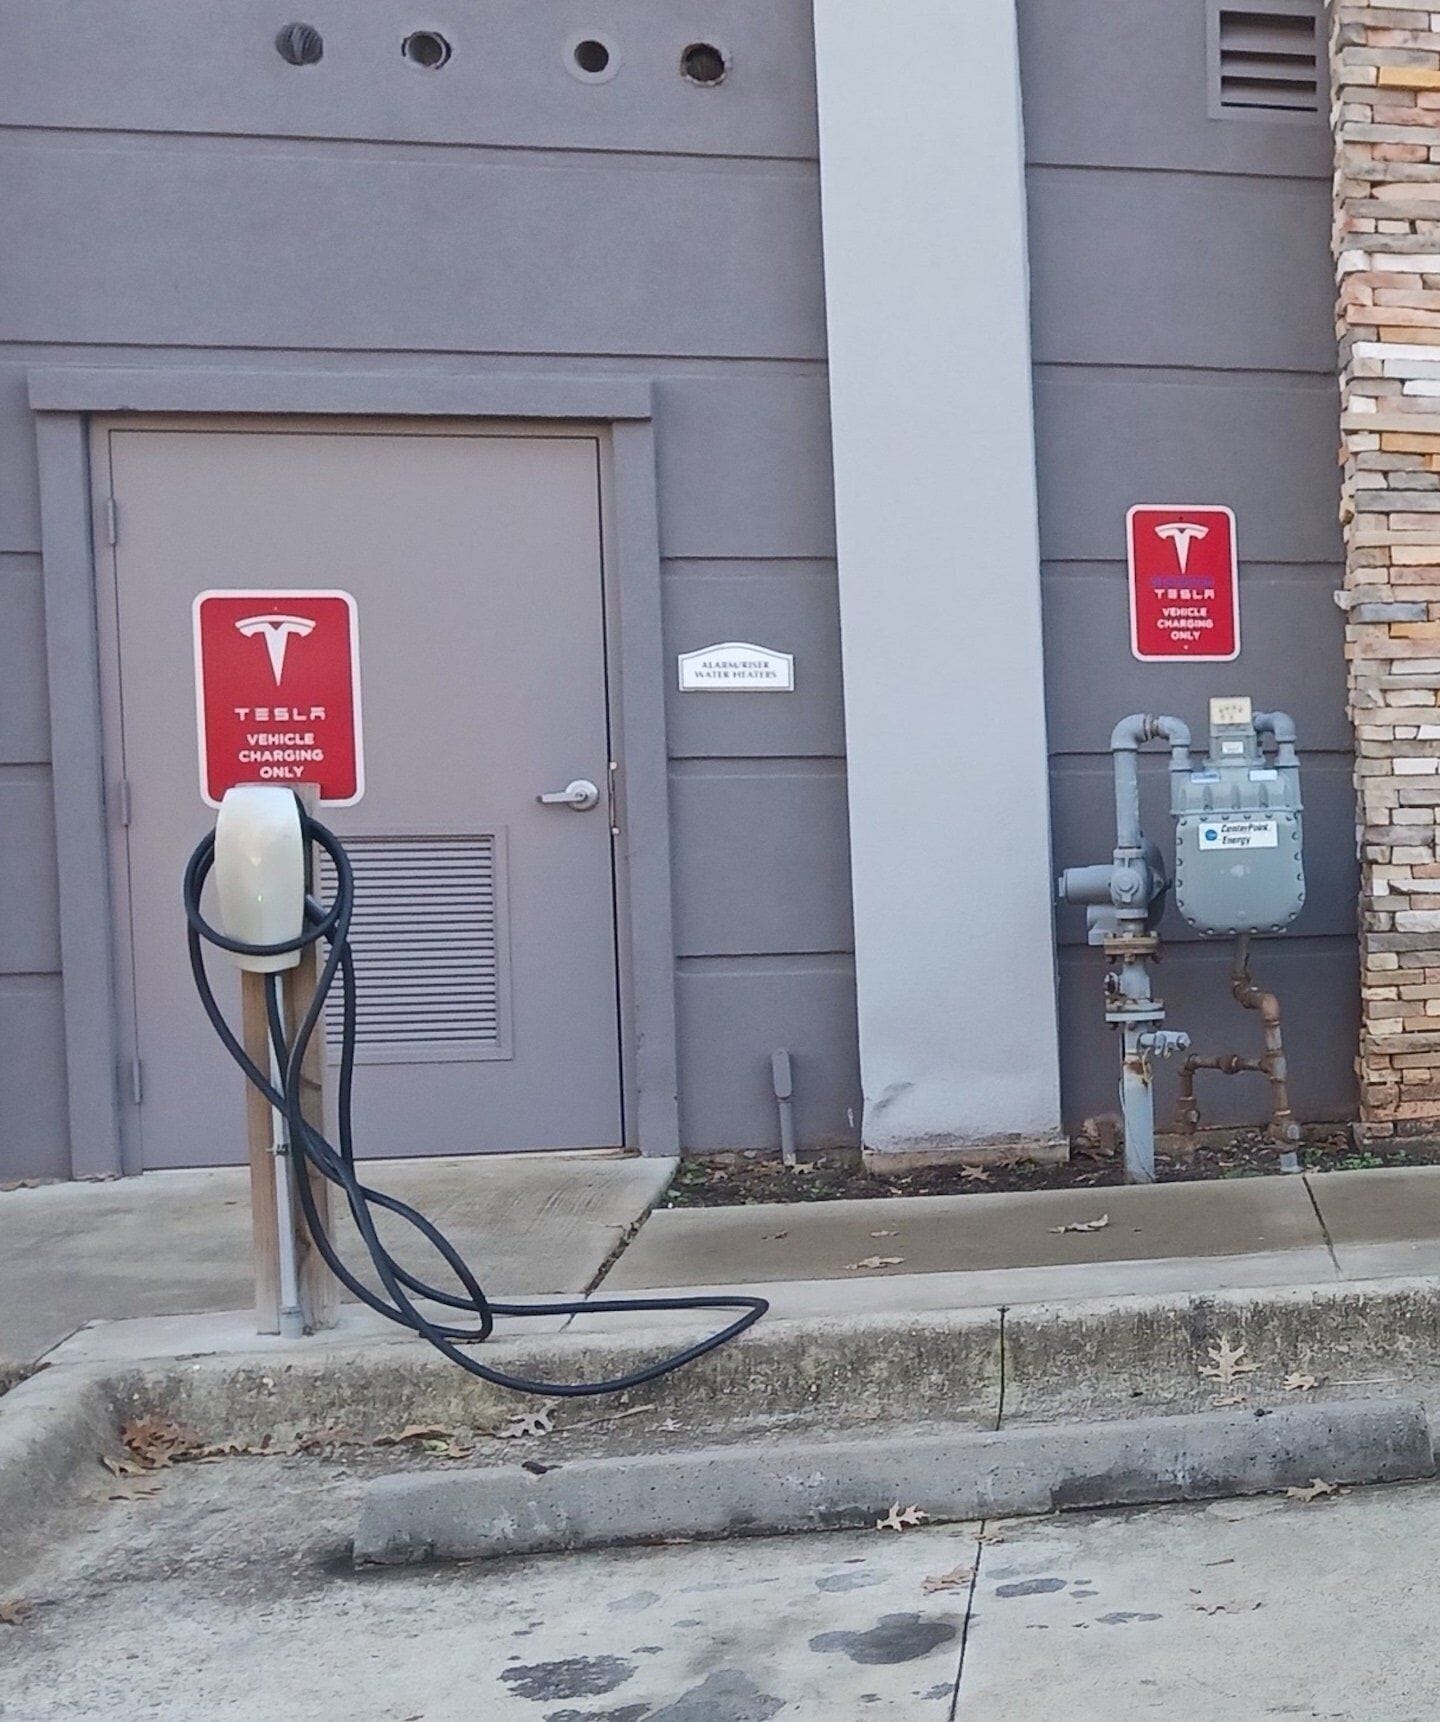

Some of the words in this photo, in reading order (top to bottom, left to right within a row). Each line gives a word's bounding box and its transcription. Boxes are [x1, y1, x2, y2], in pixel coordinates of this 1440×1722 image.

[1154, 589, 1215, 600] TESLA
[1162, 607, 1208, 617] VEHICLE
[1157, 619, 1214, 629] CHARGING
[1171, 630, 1201, 641] ONLY
[695, 671, 730, 679] WATER
[733, 671, 777, 679] HEATERS
[234, 707, 326, 721] TESLA
[247, 733, 315, 746] VEHICLE
[239, 749, 324, 763] CHARGING
[260, 766, 305, 779] ONLY
[1221, 824, 1268, 833] CenterPoint
[1222, 835, 1251, 845] Energy
